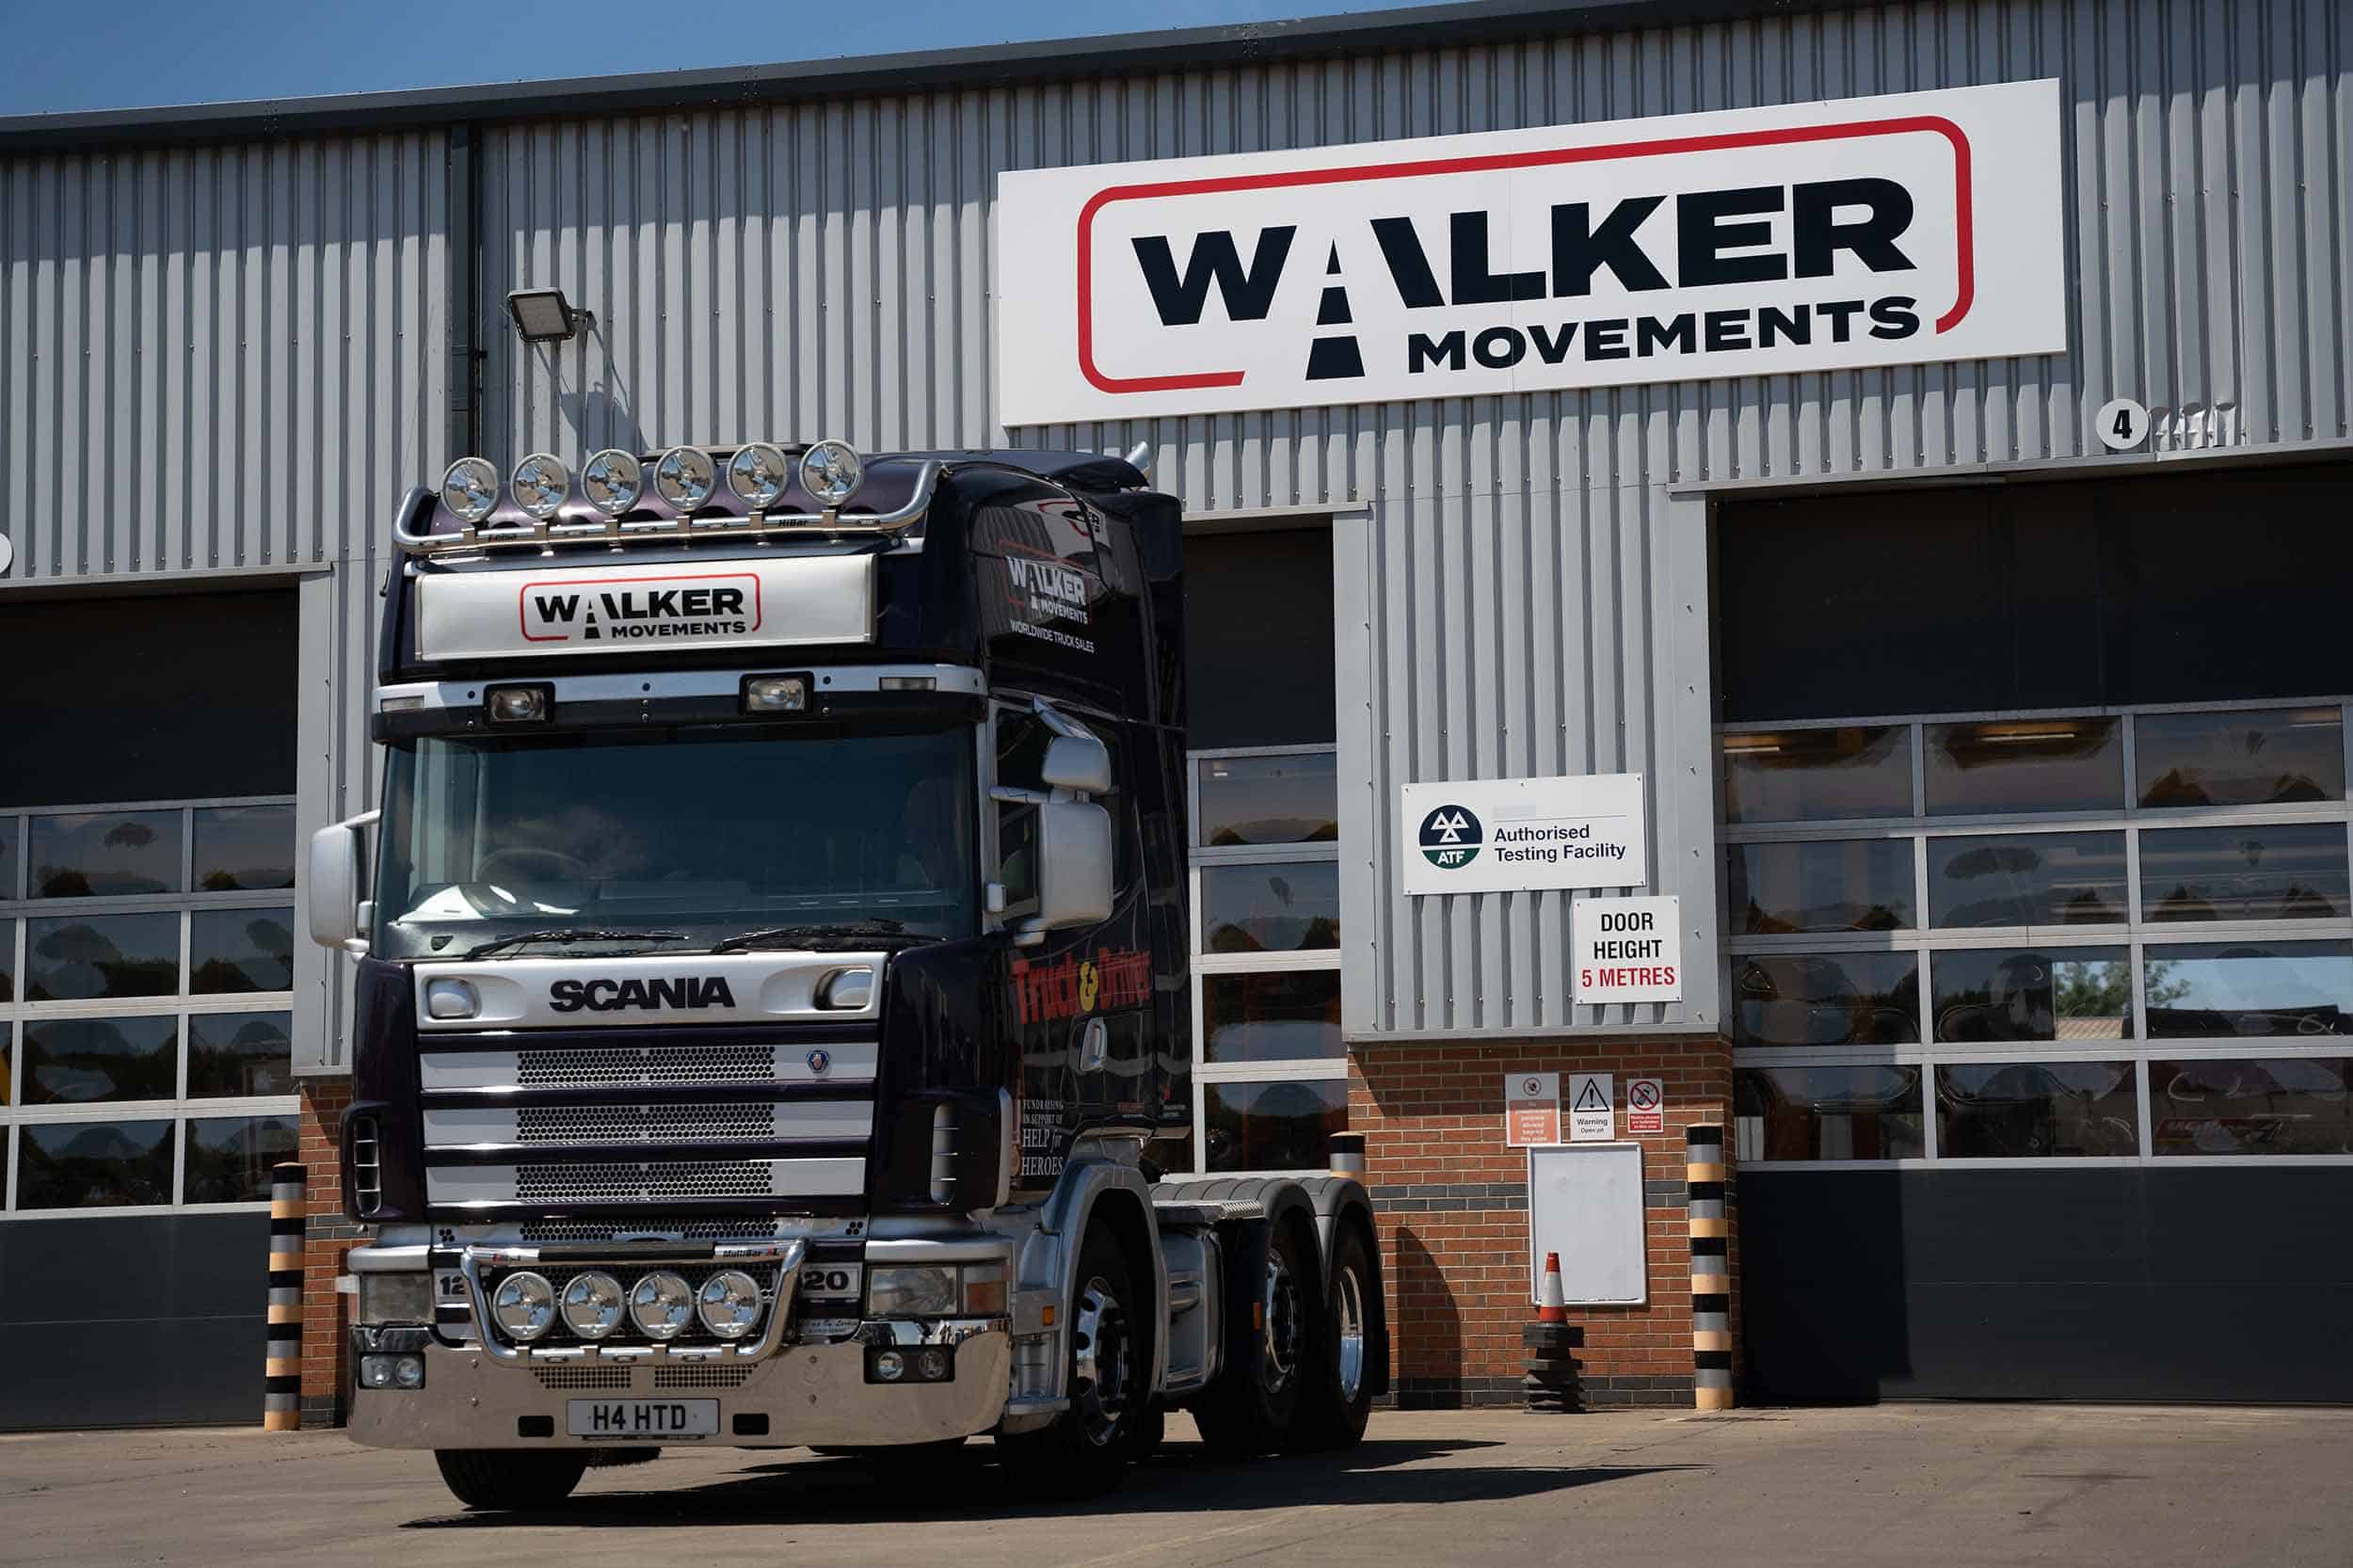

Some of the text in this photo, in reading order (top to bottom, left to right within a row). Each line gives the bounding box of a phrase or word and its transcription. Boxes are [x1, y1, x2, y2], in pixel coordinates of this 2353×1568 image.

[1130, 177, 1916, 381] WALKER
[1408, 296, 1920, 374] MOVEMENTS
[2112, 408, 2133, 440] 4
[1006, 556, 1086, 610] WALKER
[535, 588, 744, 639] WALKER
[1041, 599, 1088, 625] MOVEMENTS
[612, 620, 745, 638] MOVEMENTS
[1010, 620, 1095, 653] WORLDWIDE TRUCK SALES
[1495, 824, 1590, 842] Authorised
[1437, 851, 1465, 864] ATF
[1495, 843, 1625, 863] Testing Facility
[1601, 913, 1653, 931] DOOR
[1593, 940, 1662, 959] HEIGHT
[1009, 948, 1151, 1025] Truck & Driver
[1582, 967, 1675, 987] 5 METRES
[549, 976, 735, 1012] SCANIA
[1023, 1099, 1064, 1110] FUNDRAISING
[1577, 1117, 1609, 1127] Warning
[1022, 1128, 1062, 1153] HELP for
[1021, 1157, 1064, 1176] HEROES
[798, 1271, 849, 1290] 20
[593, 1404, 686, 1431] H4 HTD
